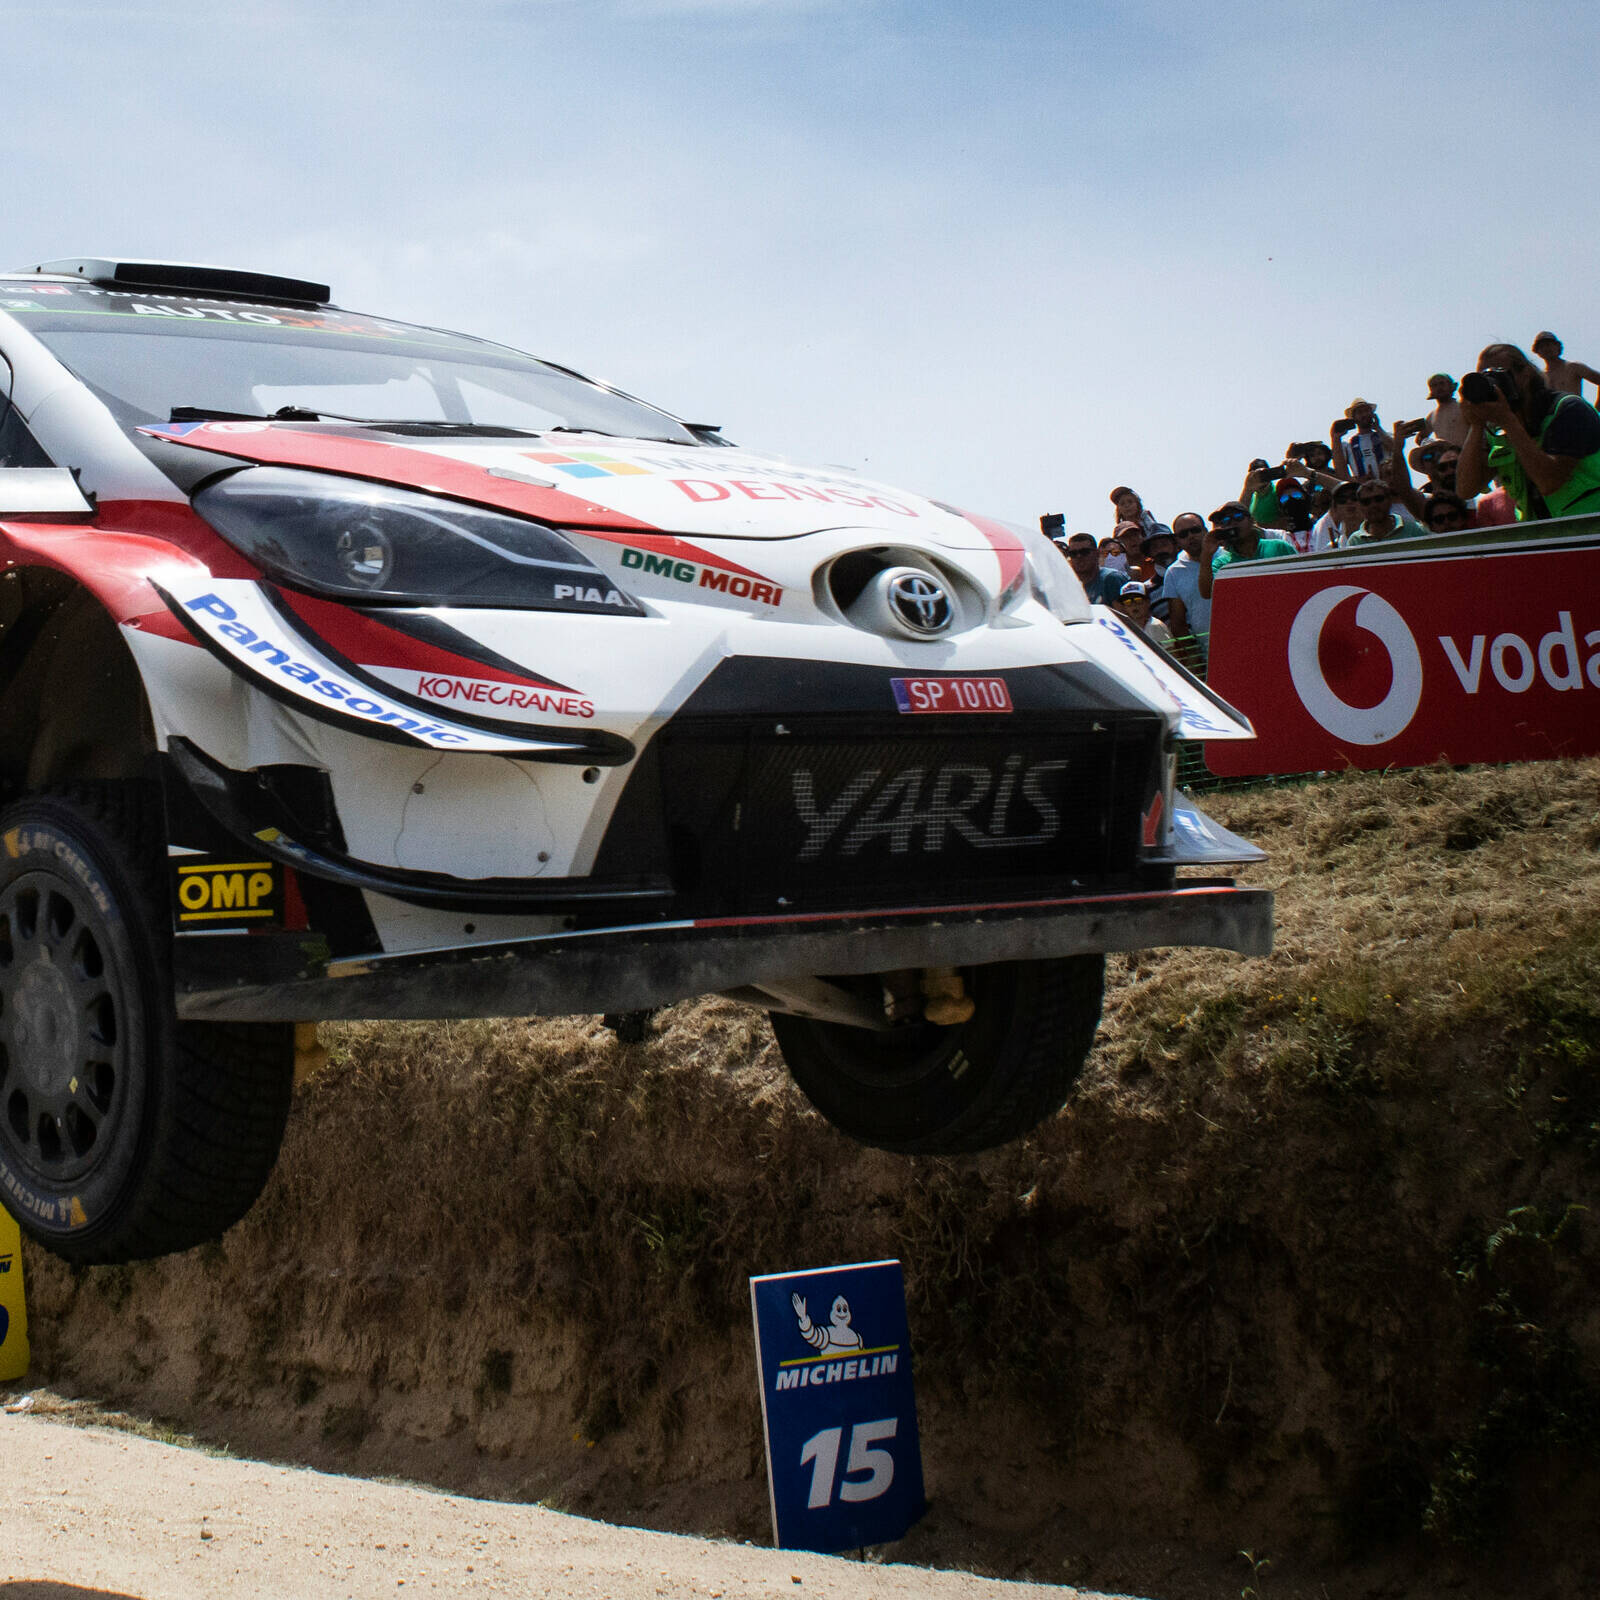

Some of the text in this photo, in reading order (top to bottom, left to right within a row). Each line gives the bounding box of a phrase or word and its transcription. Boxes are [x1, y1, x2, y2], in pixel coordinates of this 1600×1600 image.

[667, 479, 920, 518] DENSO
[554, 584, 625, 608] PIAA
[621, 548, 784, 607] DMG MORI
[184, 593, 469, 744] Panasonic
[418, 676, 595, 718] KONECRANES
[910, 681, 1006, 709] SP 1010
[178, 872, 273, 910] OMP
[775, 1354, 898, 1391] MICHELIN
[800, 1417, 898, 1509] 15
